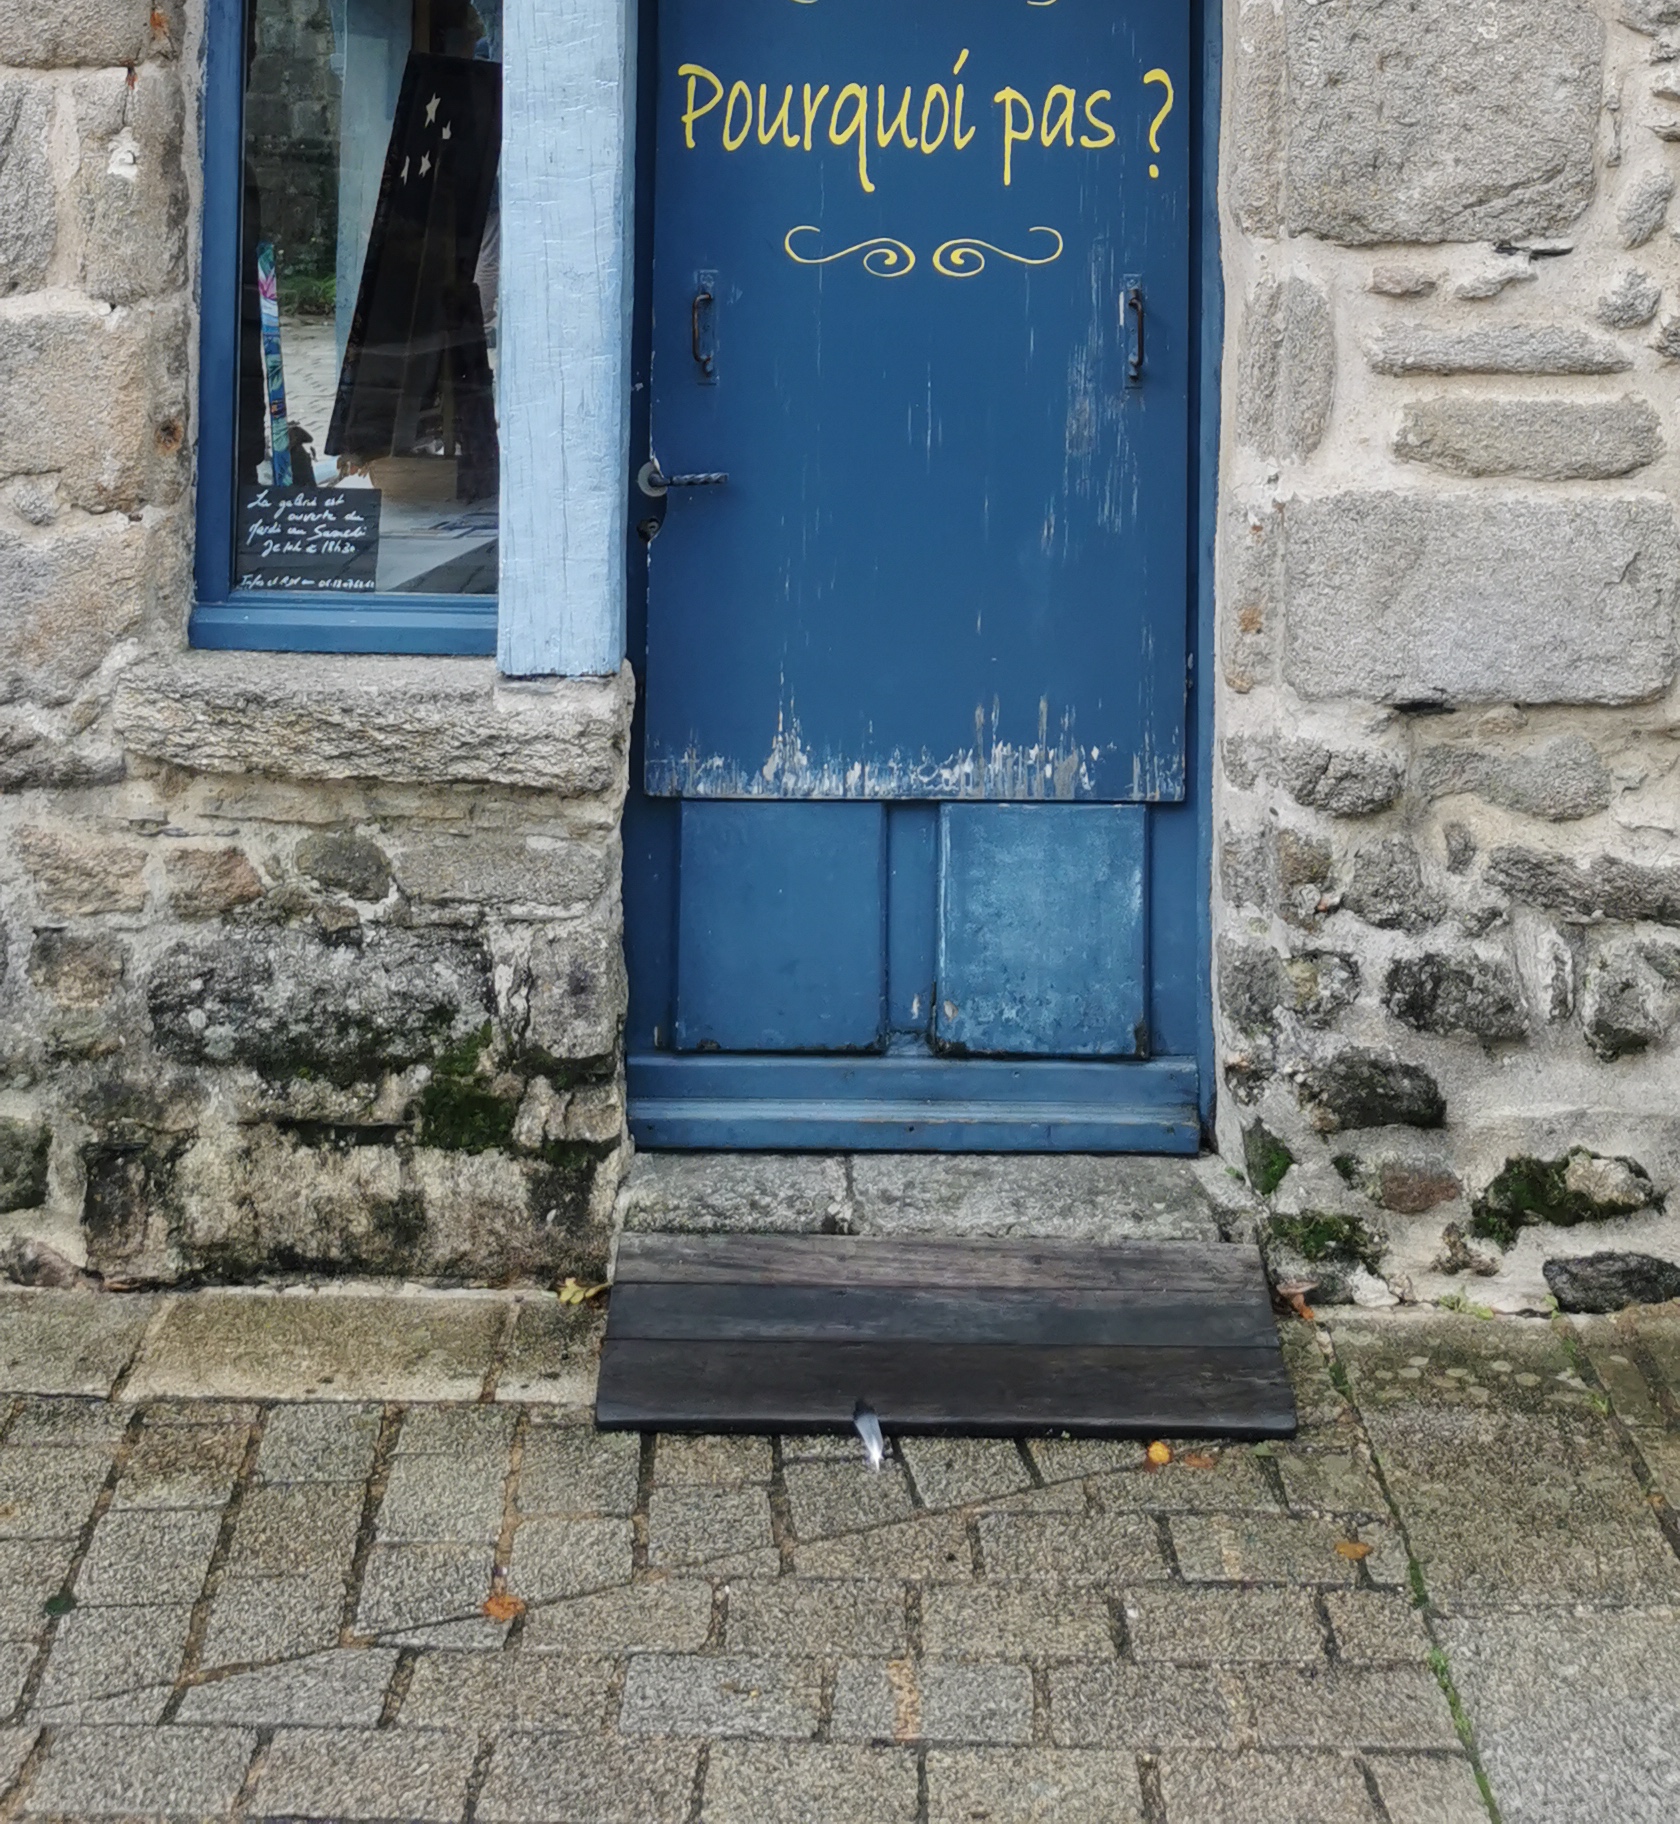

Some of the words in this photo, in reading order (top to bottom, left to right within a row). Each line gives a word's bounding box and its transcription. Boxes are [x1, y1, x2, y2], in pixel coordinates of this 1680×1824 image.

[678, 48, 977, 193] Pourquoi
[993, 83, 1116, 187] pas
[1142, 67, 1175, 180] ?
[344, 510, 365, 521] du
